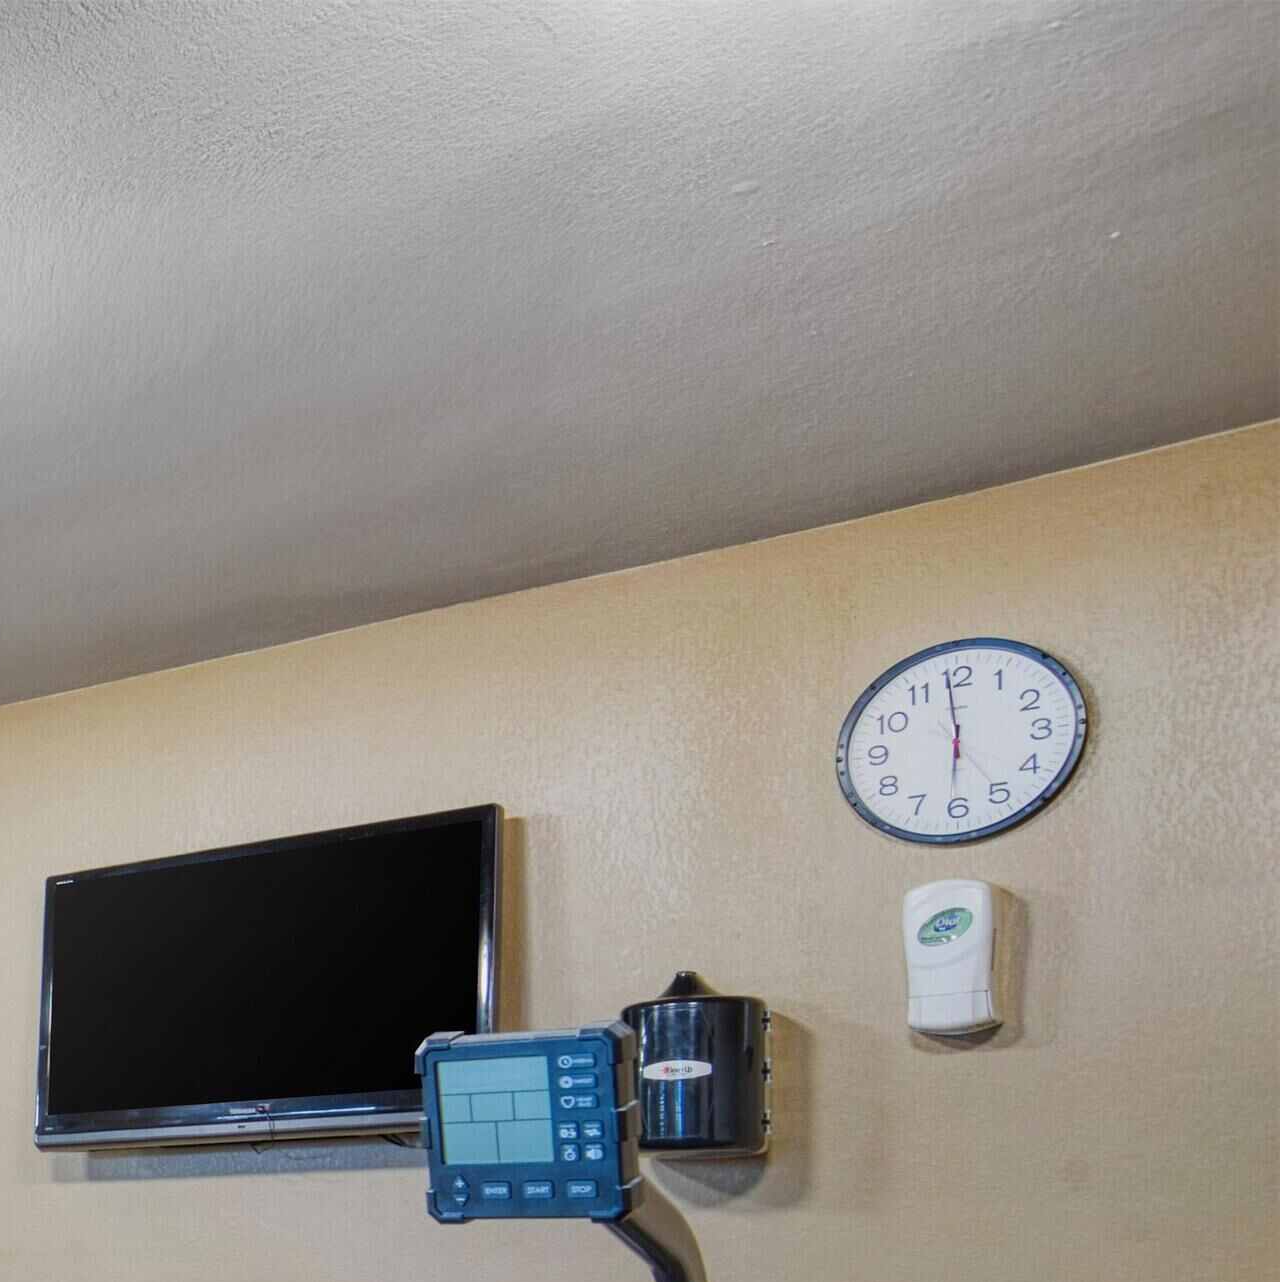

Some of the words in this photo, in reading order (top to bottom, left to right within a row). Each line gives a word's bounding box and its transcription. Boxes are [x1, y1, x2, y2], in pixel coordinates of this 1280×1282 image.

[941, 665, 973, 690] 12
[993, 669, 1003, 691] 1
[907, 682, 929, 706] 11
[1019, 688, 1041, 712] 2
[876, 711, 909, 735] 10
[1029, 717, 1052, 741] 3
[868, 744, 889, 766] 9
[1018, 752, 1041, 775] 4
[879, 775, 899, 796] 8
[988, 781, 1011, 805] 5
[907, 793, 928, 817] 7
[947, 796, 970, 819] 6
[484, 1186, 508, 1196] ENTER
[527, 1185, 550, 1195] START
[570, 1184, 592, 1194] STOP
